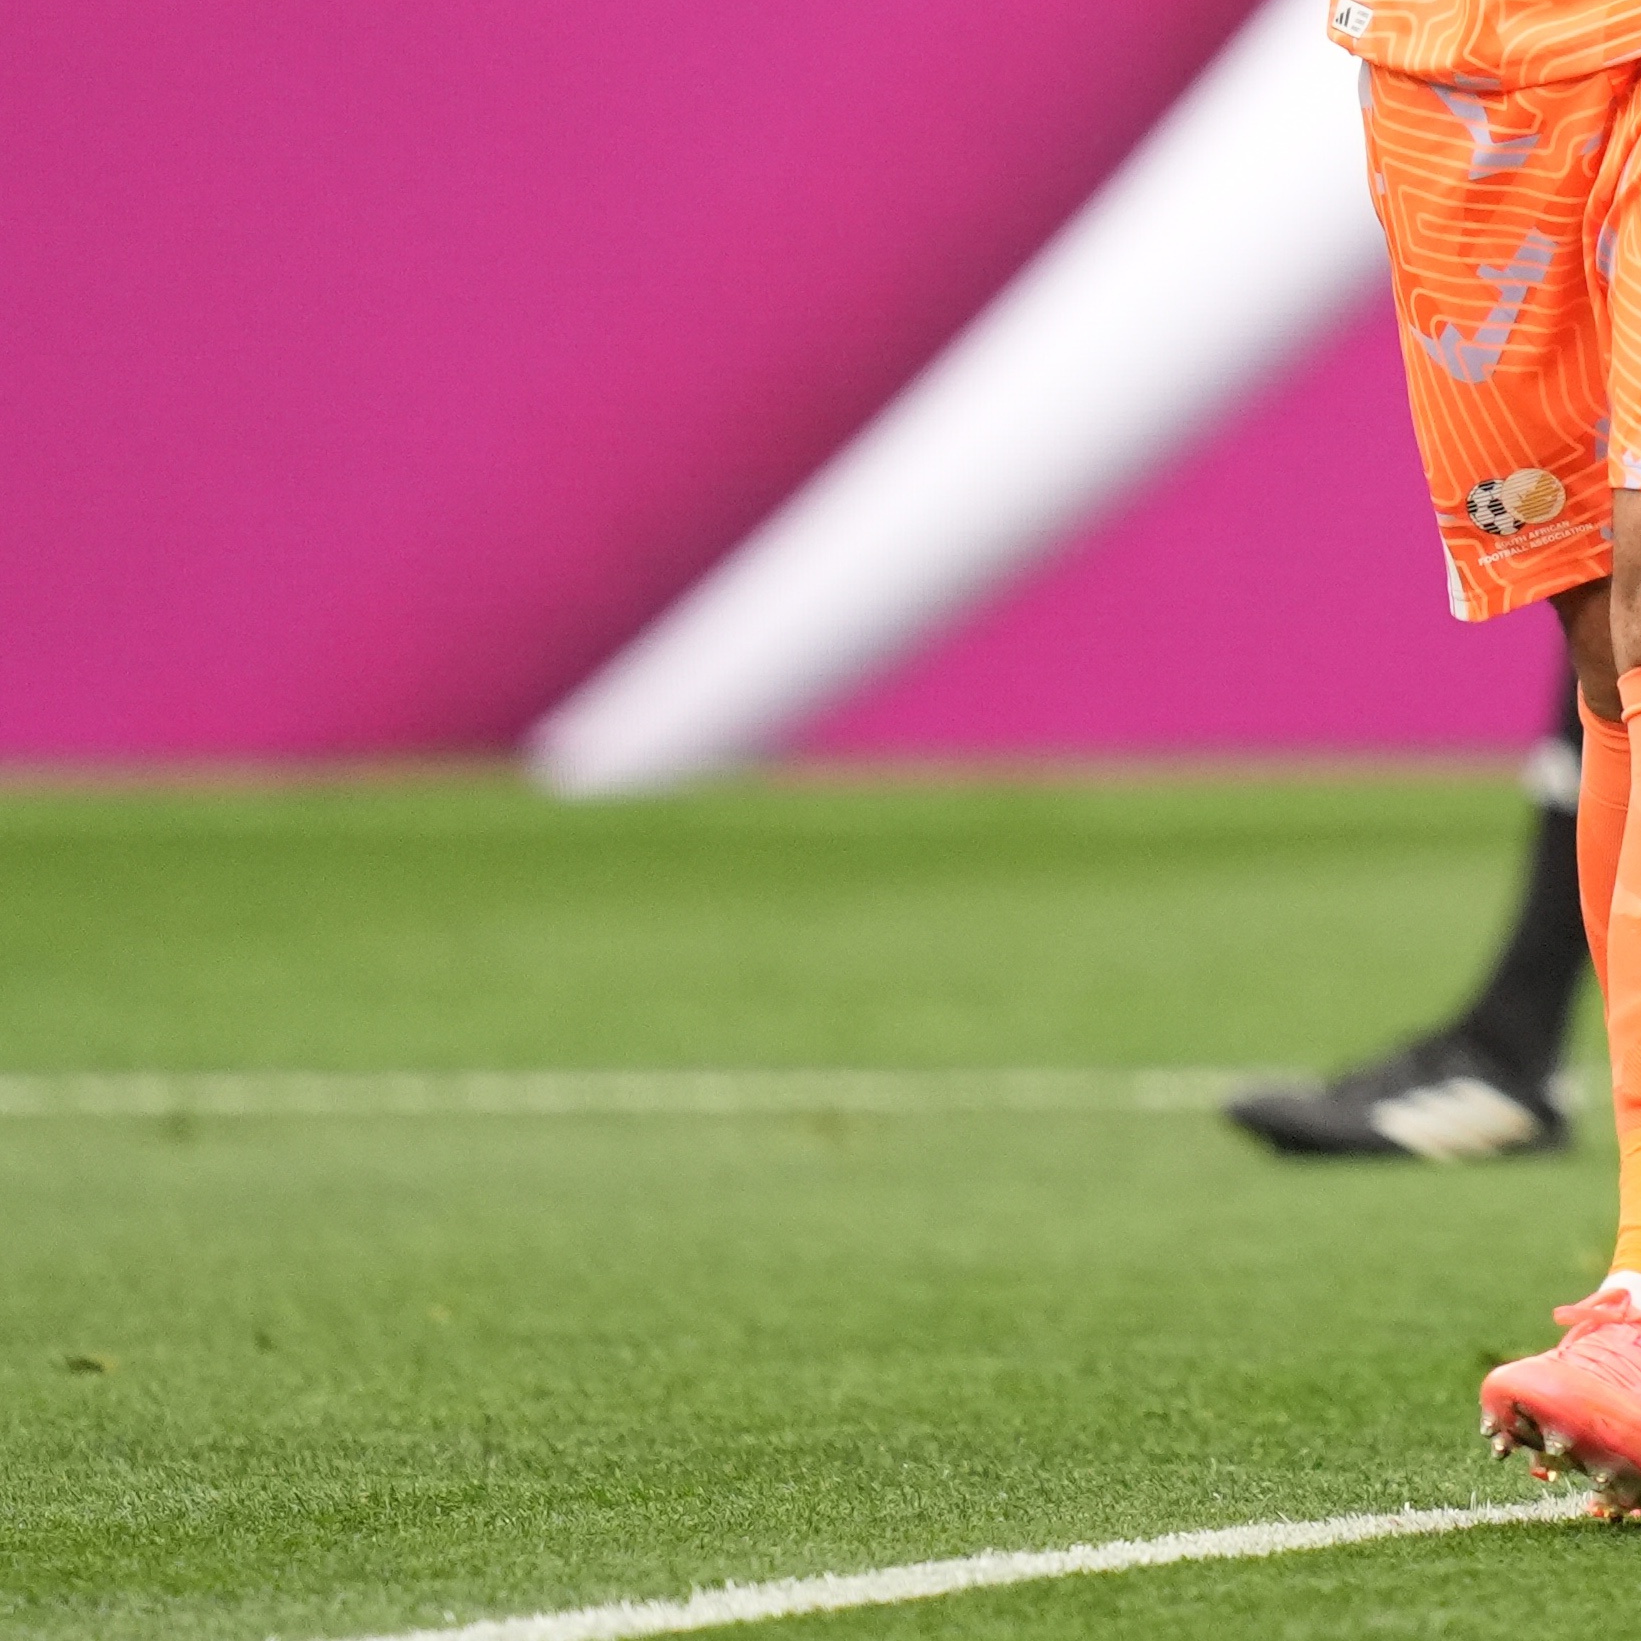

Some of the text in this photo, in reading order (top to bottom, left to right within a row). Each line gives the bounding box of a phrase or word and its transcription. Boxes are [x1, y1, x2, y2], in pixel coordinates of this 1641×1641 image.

[1478, 523, 1593, 566] FOOTBALL ASSOCIATION
[1495, 520, 1570, 550] SOUTH AFRICAN
